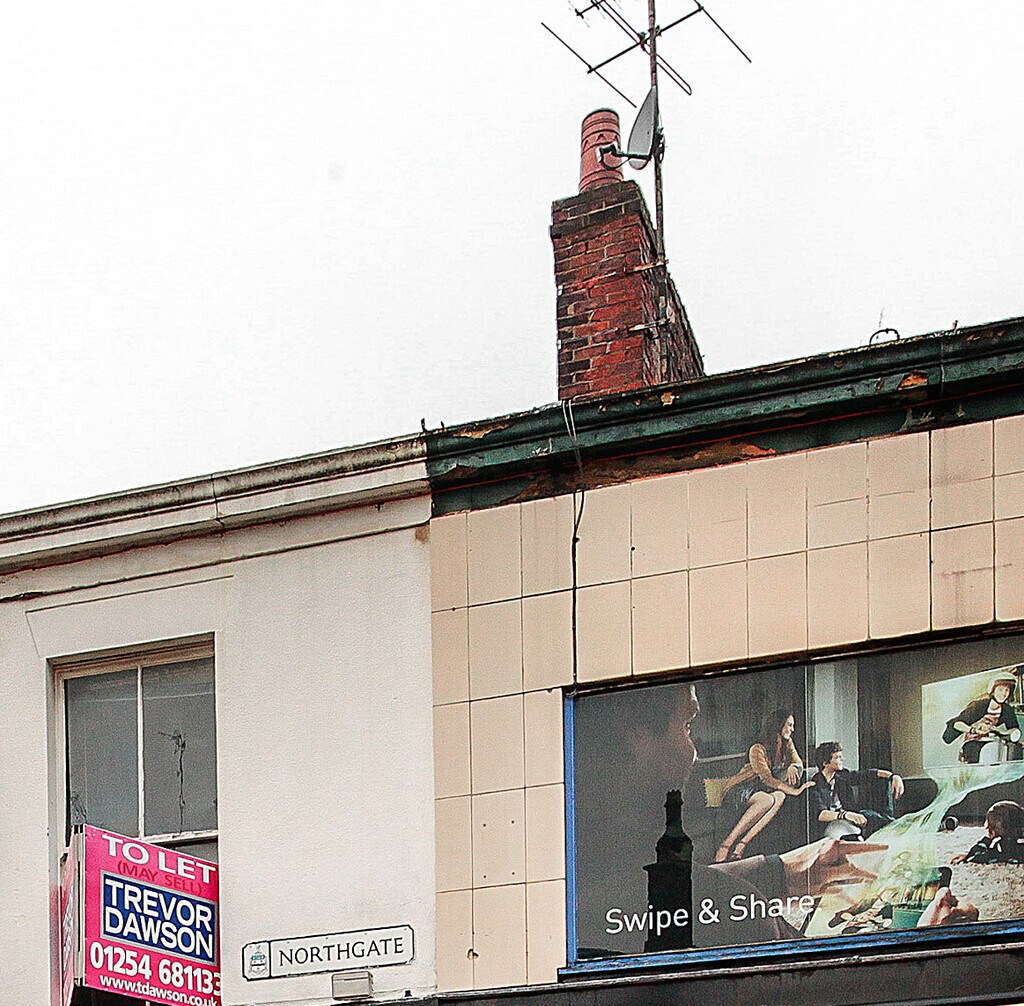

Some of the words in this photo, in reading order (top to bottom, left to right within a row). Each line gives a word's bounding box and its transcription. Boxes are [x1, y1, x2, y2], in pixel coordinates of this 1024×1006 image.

[101, 833, 150, 866] TO
[158, 850, 217, 885] LET
[104, 878, 213, 932] TREVOR
[605, 904, 690, 937] Swipe
[698, 898, 721, 925] &
[104, 905, 214, 959] DAWSON
[279, 937, 405, 967] NORTHGATE
[89, 941, 153, 981] 01254
